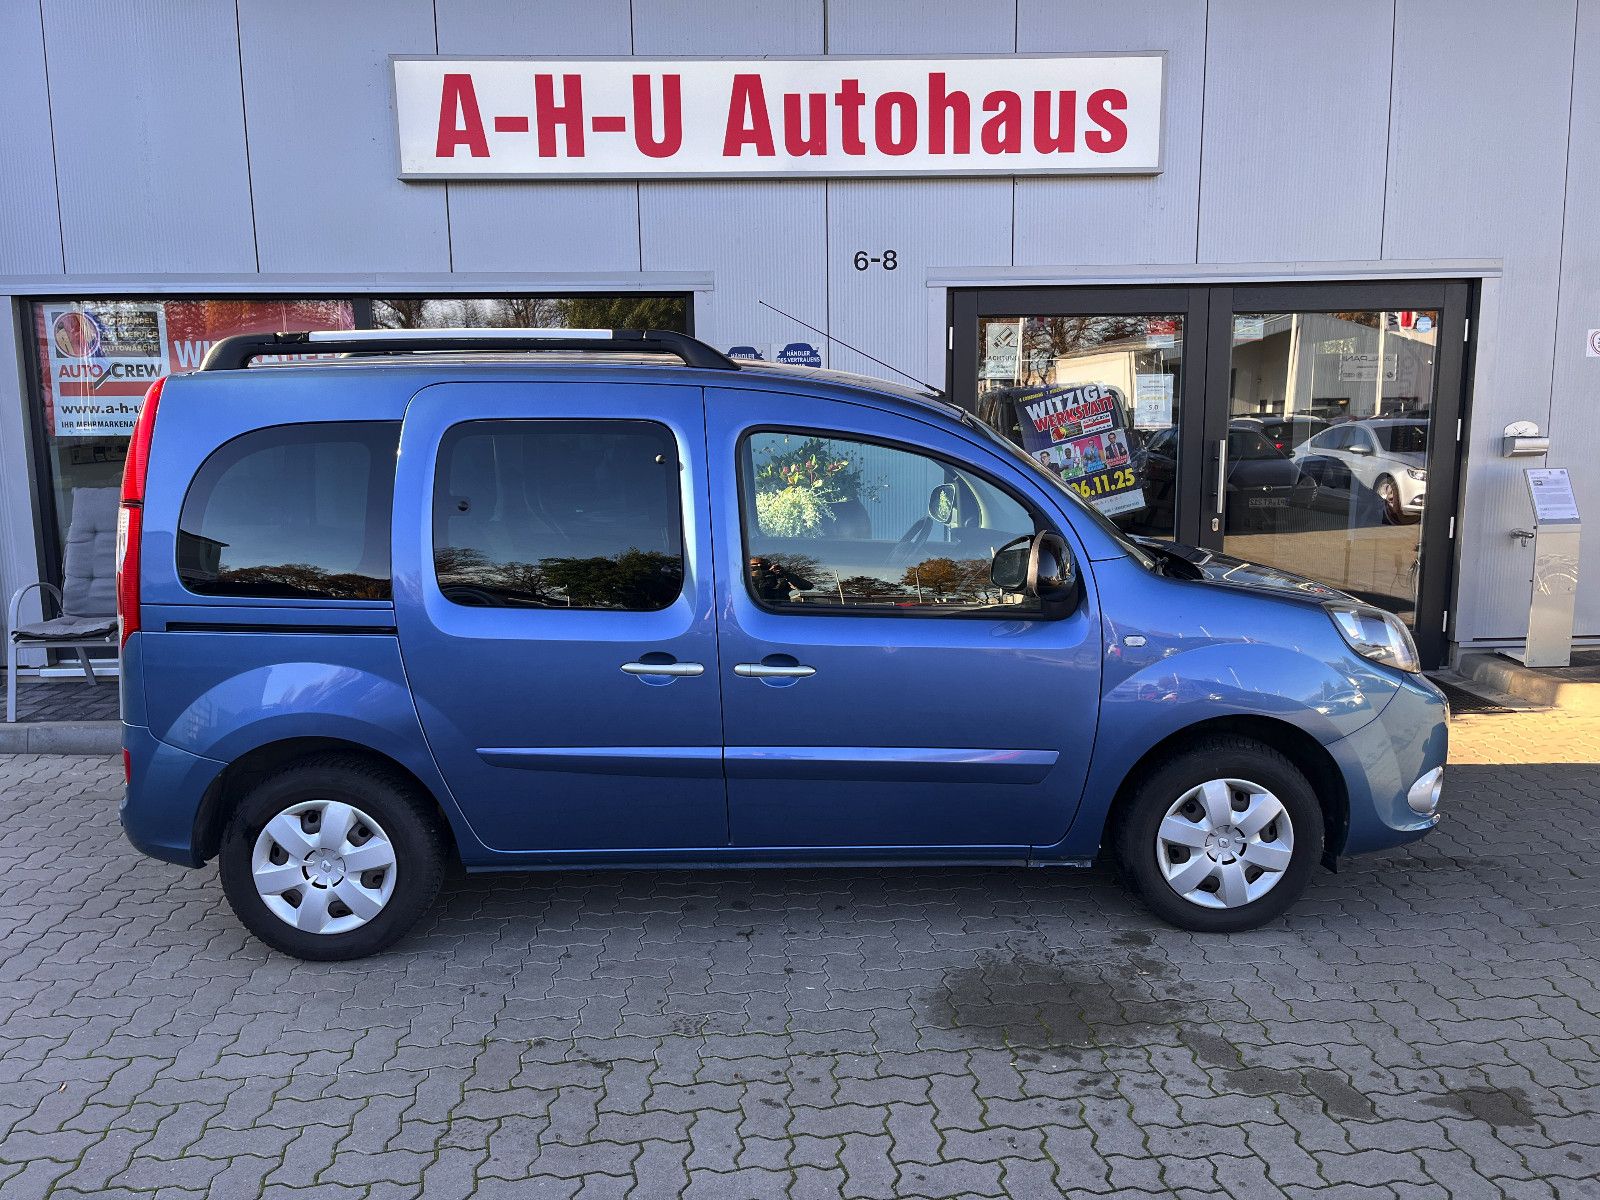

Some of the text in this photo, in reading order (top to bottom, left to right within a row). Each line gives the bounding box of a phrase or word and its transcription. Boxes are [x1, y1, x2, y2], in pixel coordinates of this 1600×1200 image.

[435, 72, 1129, 158] A-H-U Autohaus
[853, 250, 898, 271] 6-8
[786, 349, 811, 357] HÄNDLER
[59, 362, 162, 378] AUTO CREW
[1025, 384, 1111, 421] WITZIGE
[1033, 395, 1114, 432] WERKSTATT
